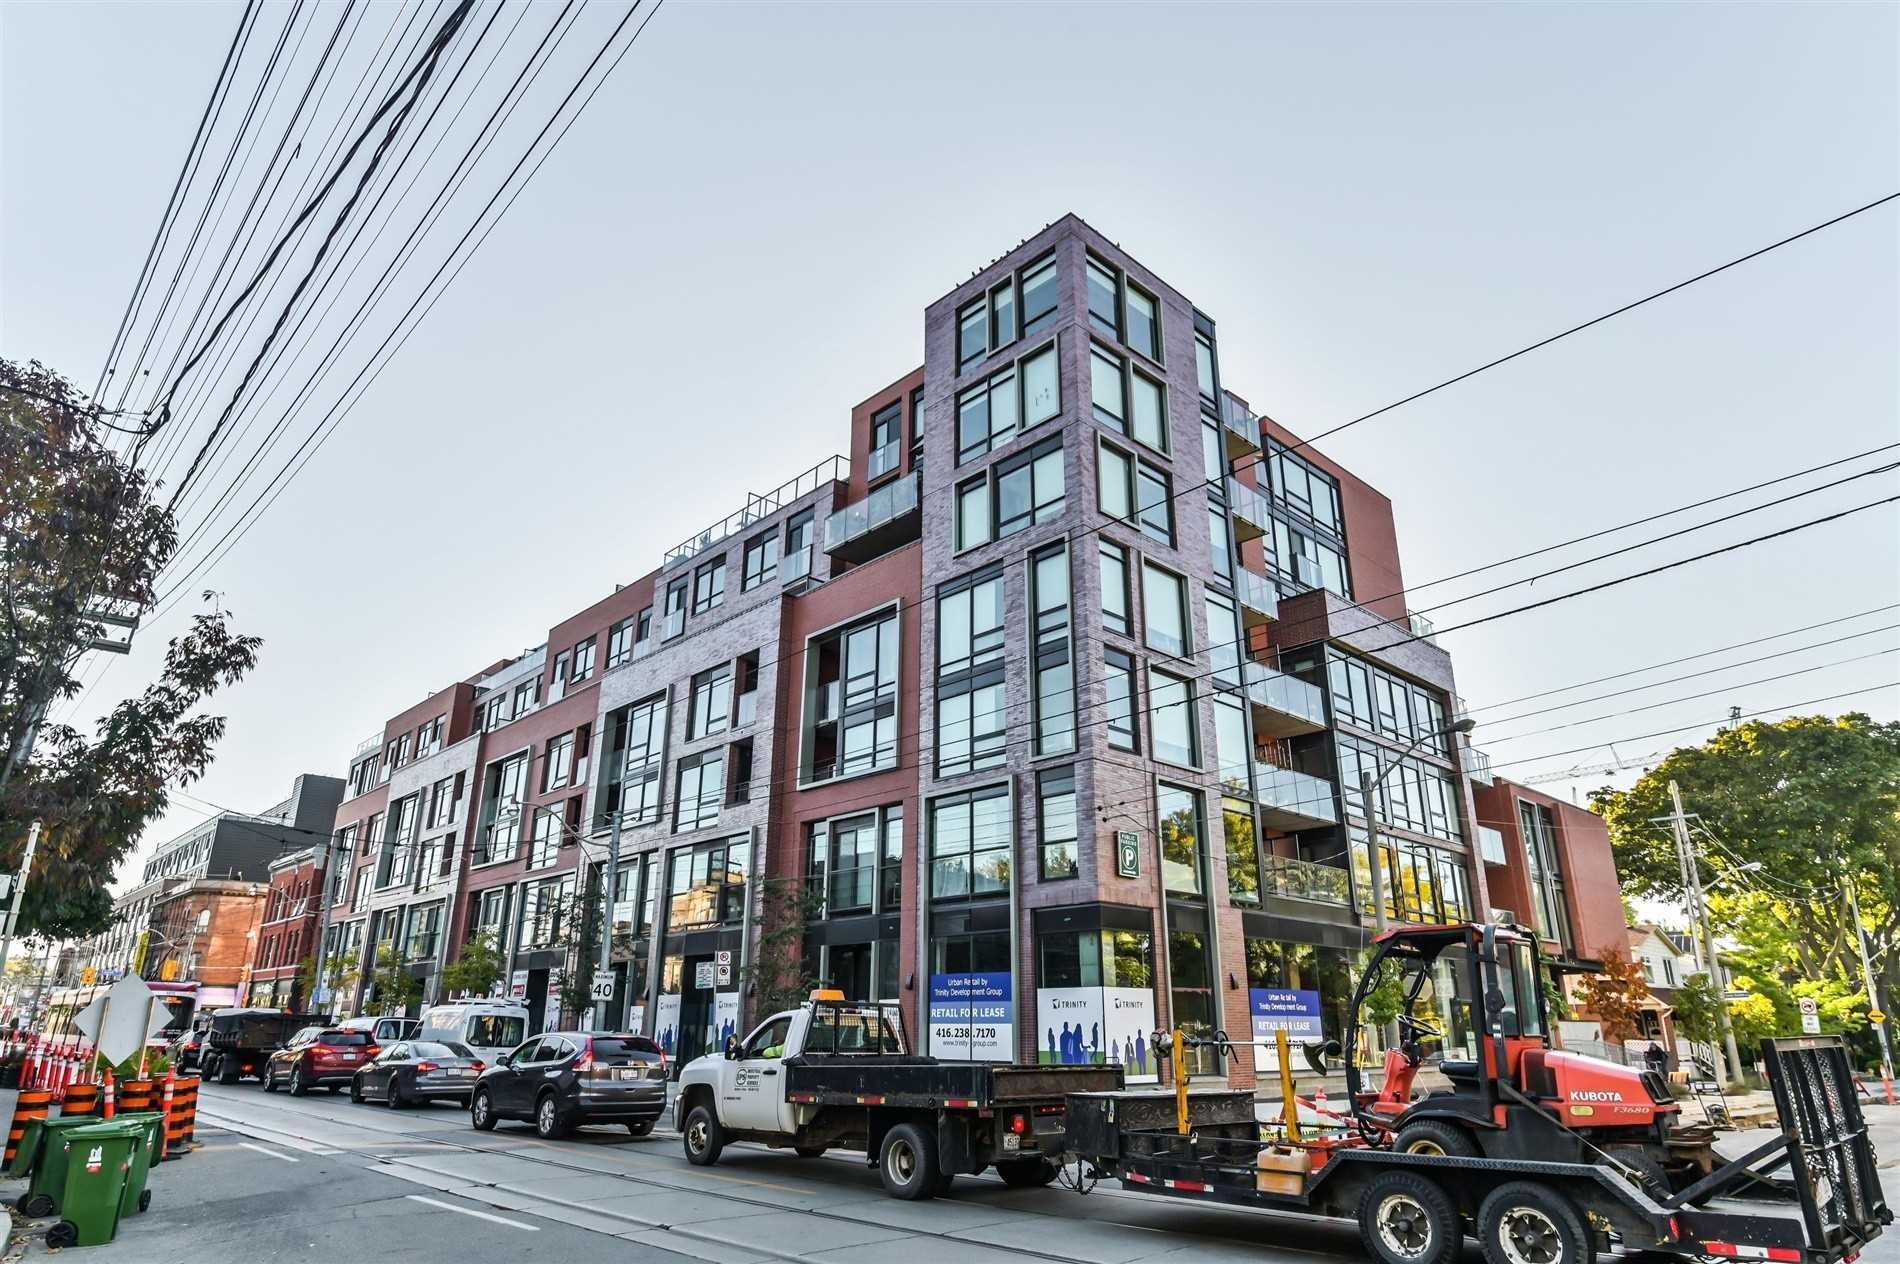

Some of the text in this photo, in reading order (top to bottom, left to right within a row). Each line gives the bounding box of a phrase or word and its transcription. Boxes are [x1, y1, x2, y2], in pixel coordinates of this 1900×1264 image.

[1125, 849, 1134, 866] P
[947, 978, 988, 987] Urban Retail by
[593, 983, 612, 997] 40
[934, 988, 1003, 997] Trinity Development Group
[1062, 1001, 1087, 1009] TRINITY
[1123, 1001, 1144, 1009] TRINITY
[931, 1007, 1005, 1018] RETAIL FOR LEASE
[1258, 1021, 1312, 1031] RETAIL FOR LEASE
[936, 1027, 996, 1039] 416.238.7170
[1570, 1090, 1623, 1102] KUBOTA
